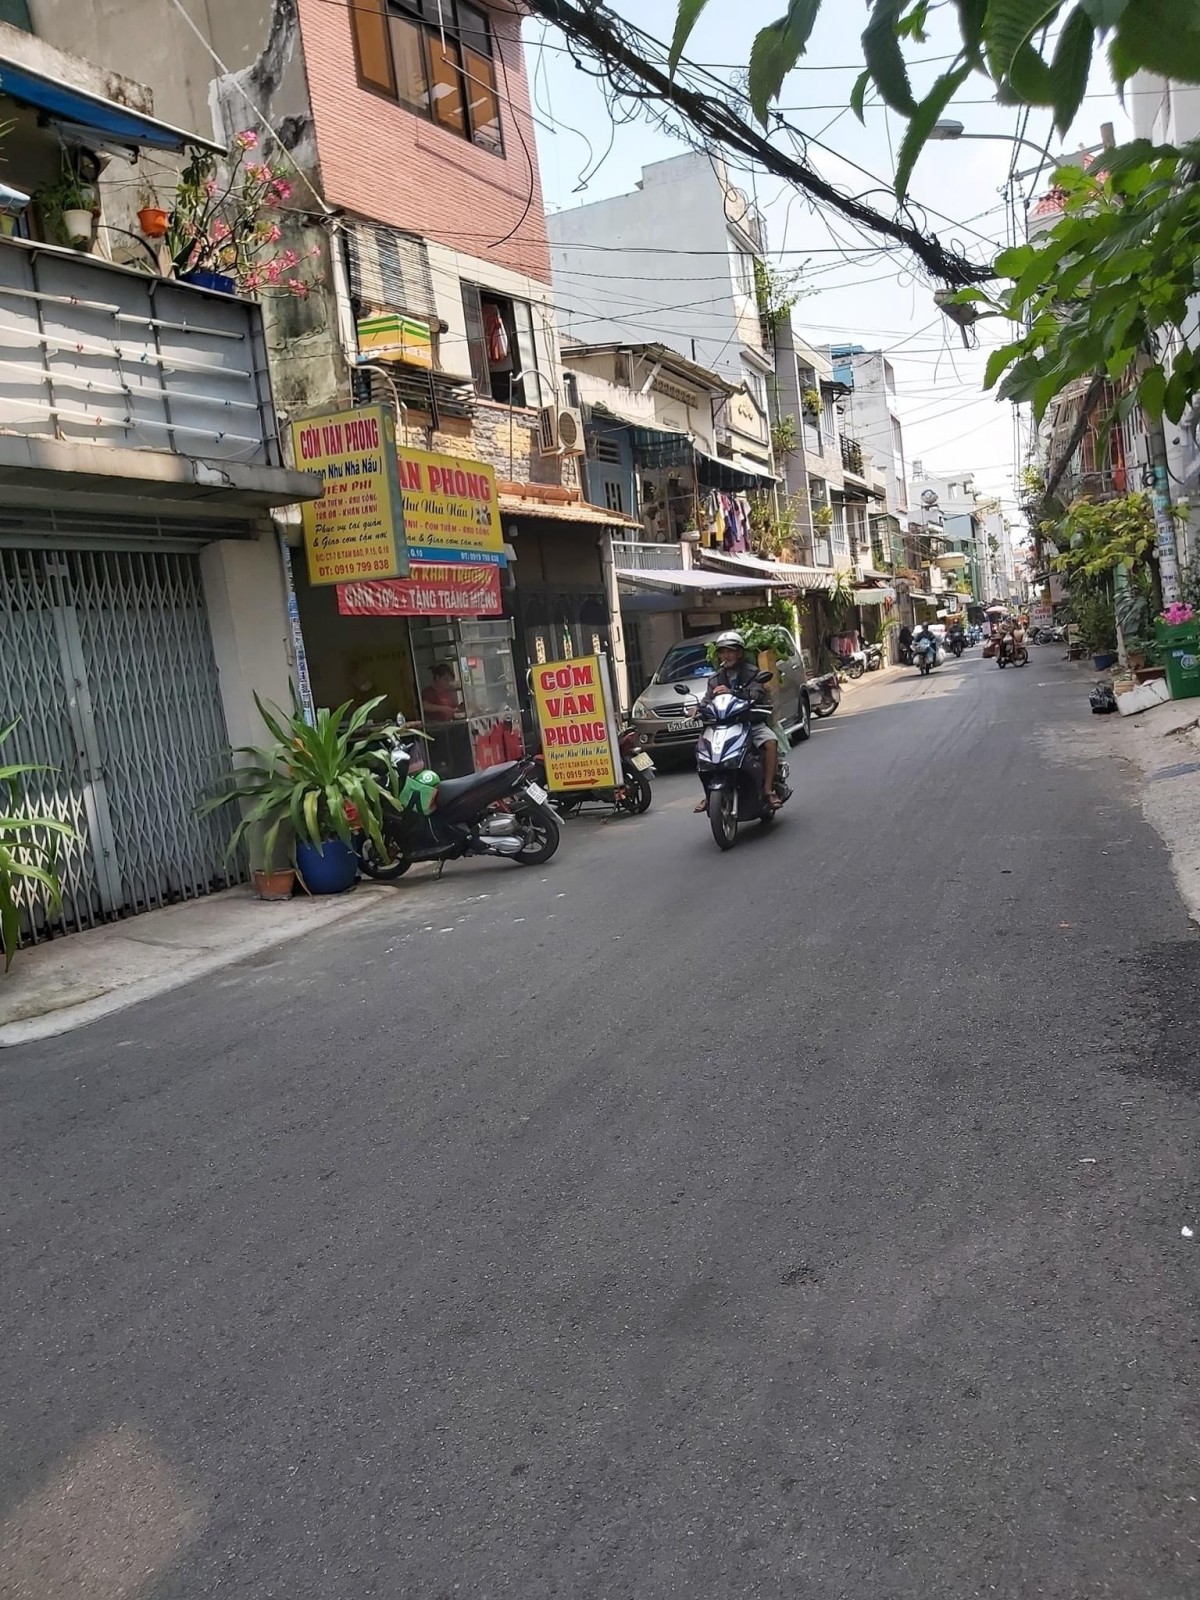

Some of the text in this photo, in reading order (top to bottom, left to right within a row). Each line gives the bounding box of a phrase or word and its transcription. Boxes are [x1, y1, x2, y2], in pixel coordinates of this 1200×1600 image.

[300, 424, 321, 460] CƠM
[344, 411, 379, 453] PHÒNG
[328, 463, 343, 479] Như
[345, 459, 360, 476] Nhà
[362, 454, 378, 474] Nấu
[427, 463, 491, 502] PHÒNG
[315, 523, 335, 535] Phục
[363, 517, 382, 531] quán
[322, 536, 340, 549] Giao
[334, 564, 354, 575] 0919
[356, 561, 371, 573] 799
[373, 559, 389, 570] 838
[540, 664, 594, 691] CƠM
[545, 692, 595, 718] VĂN
[544, 720, 607, 747] PHÒNG
[566, 770, 582, 779] 0919
[583, 769, 596, 777] 799
[597, 768, 610, 776] 838
